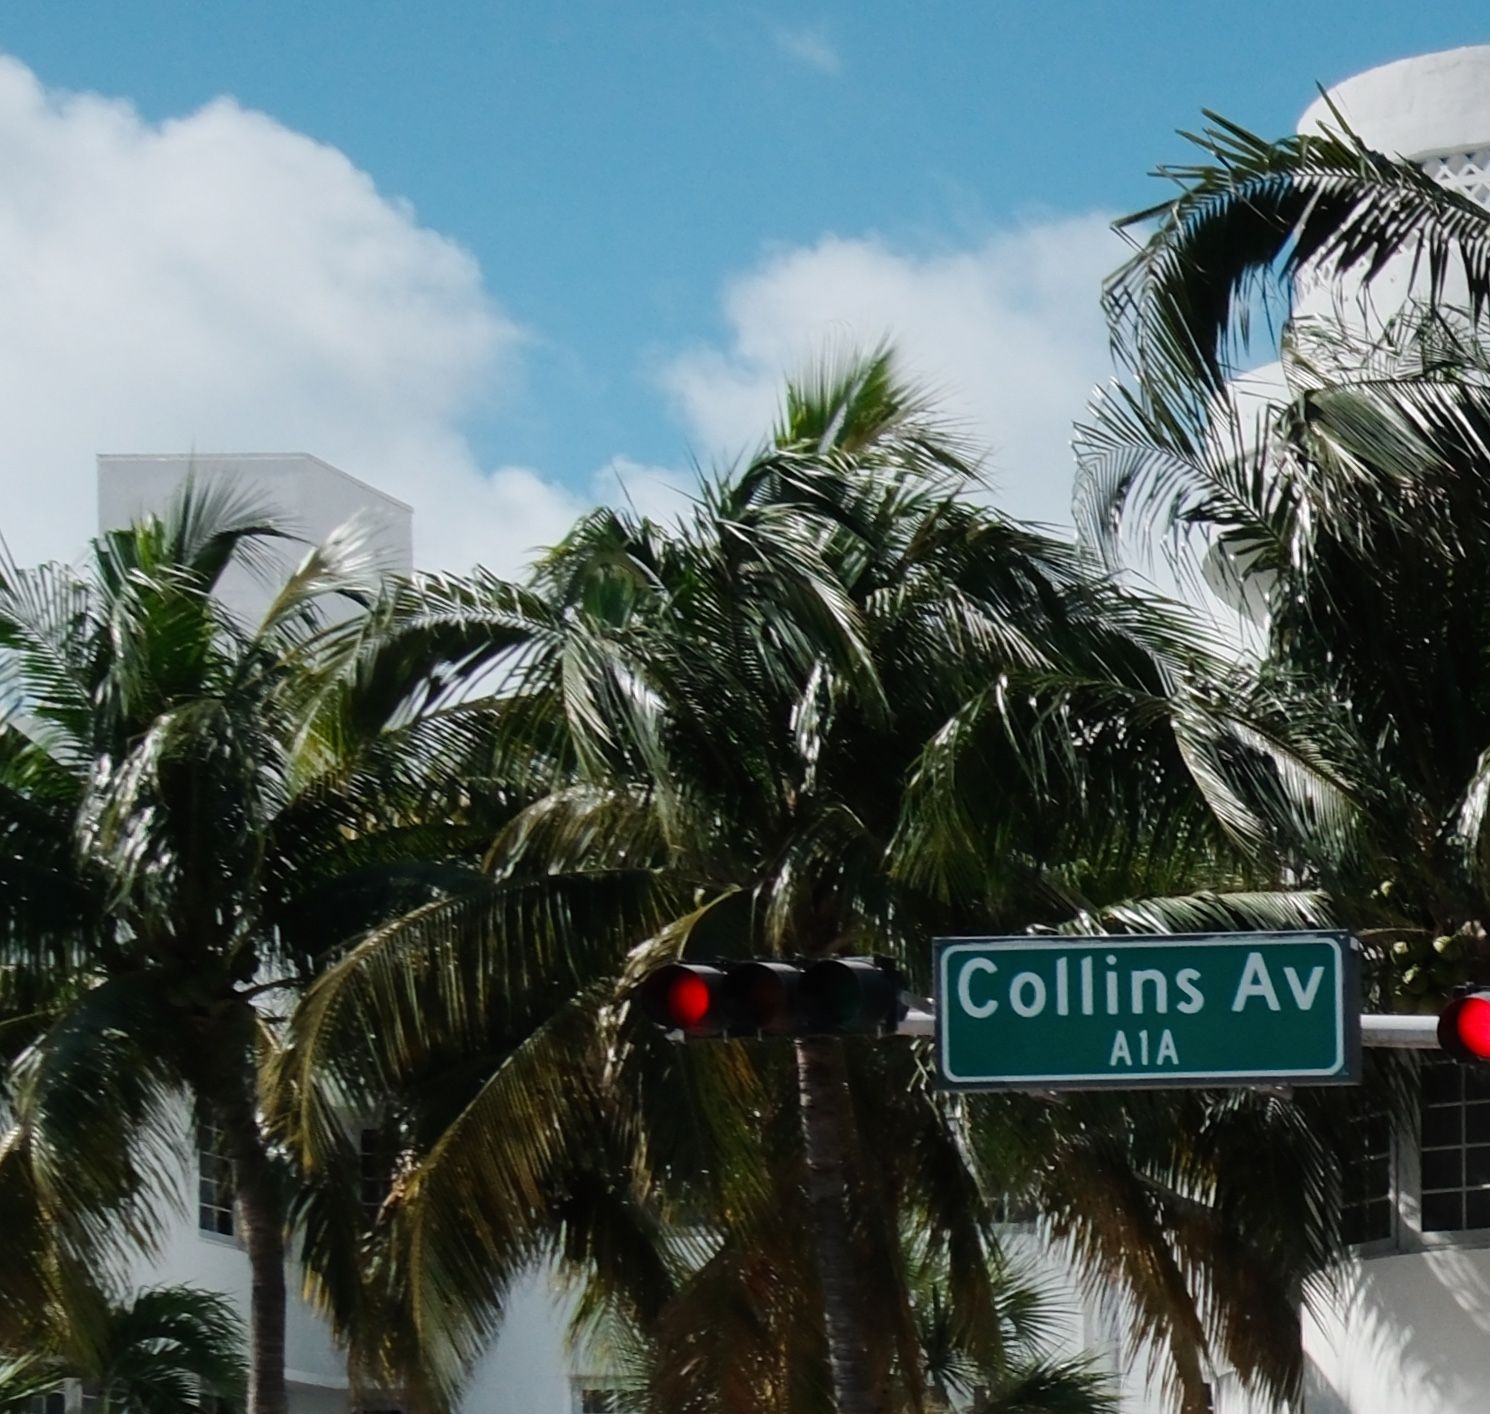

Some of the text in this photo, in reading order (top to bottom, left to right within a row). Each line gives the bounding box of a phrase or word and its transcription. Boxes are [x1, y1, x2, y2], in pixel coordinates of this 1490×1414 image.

[957, 952, 1325, 1018] Collins Av
[1109, 1029, 1180, 1066] A1A
